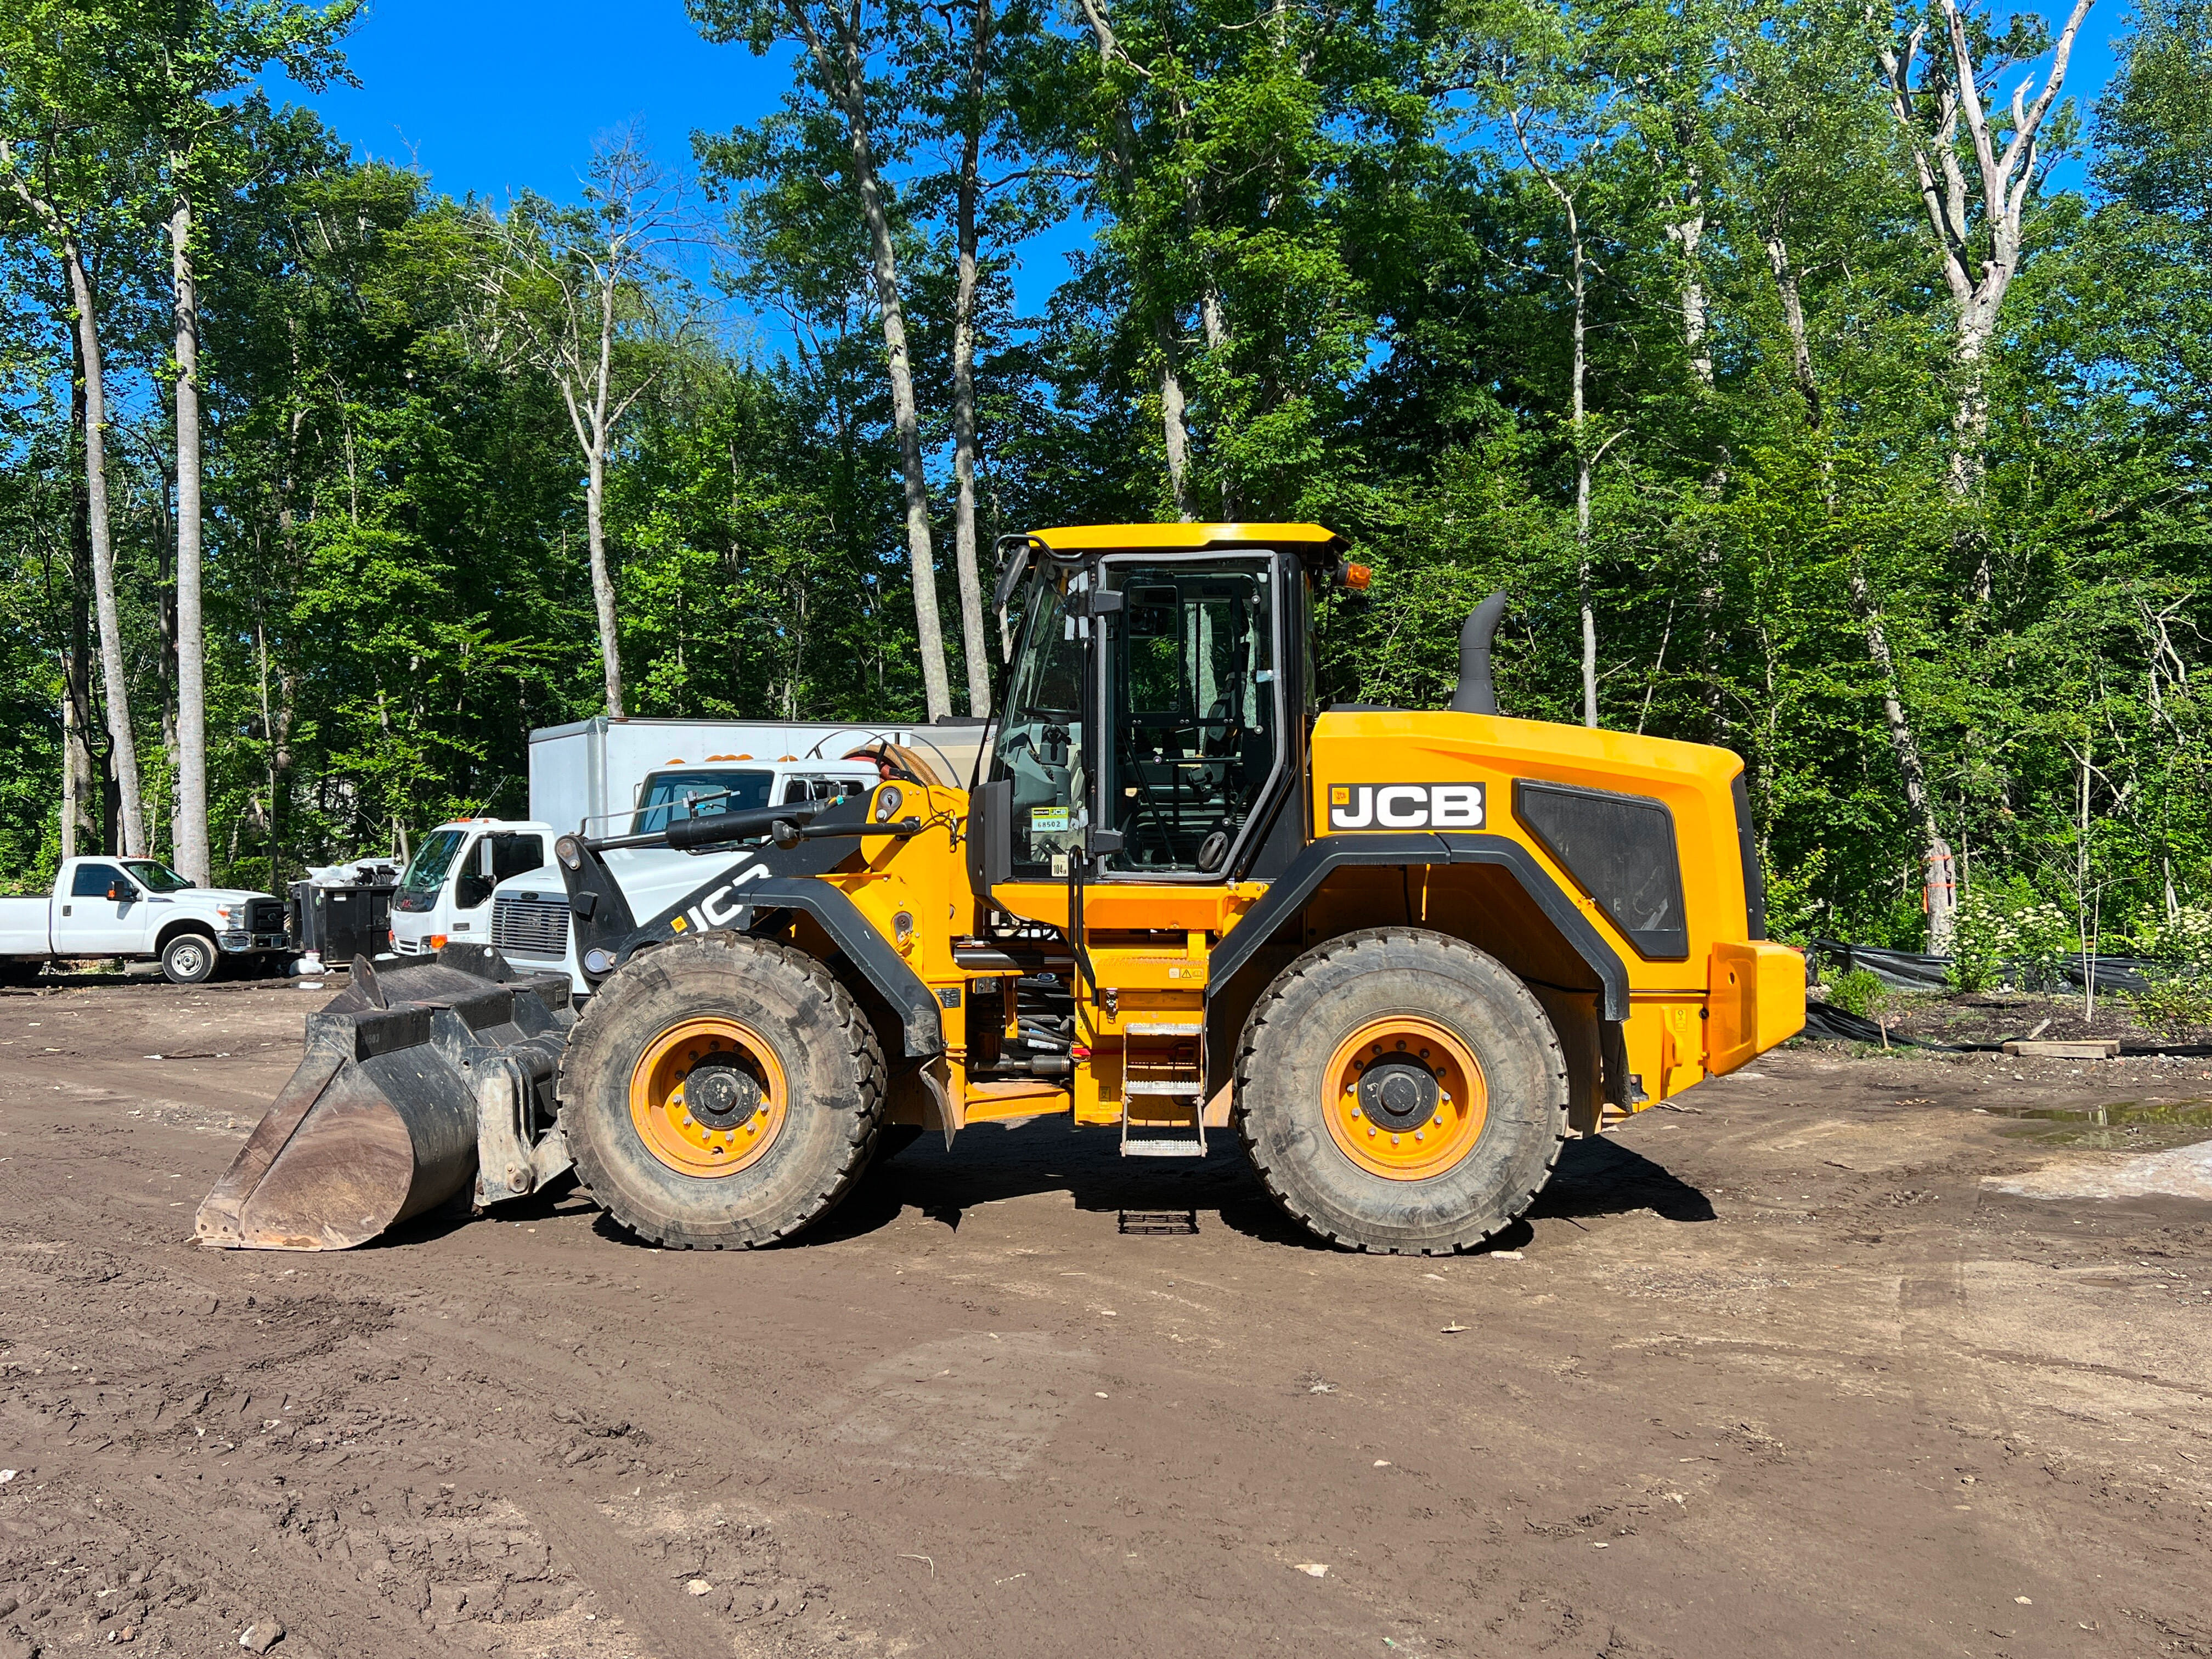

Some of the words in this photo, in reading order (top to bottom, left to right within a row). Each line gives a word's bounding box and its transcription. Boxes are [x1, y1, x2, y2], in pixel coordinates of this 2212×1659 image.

[1331, 786, 1483, 827] JCB
[1053, 864, 1063, 874] 104
[623, 998, 679, 1040] RADIAL
[1311, 1151, 1365, 1200] RADIAL
